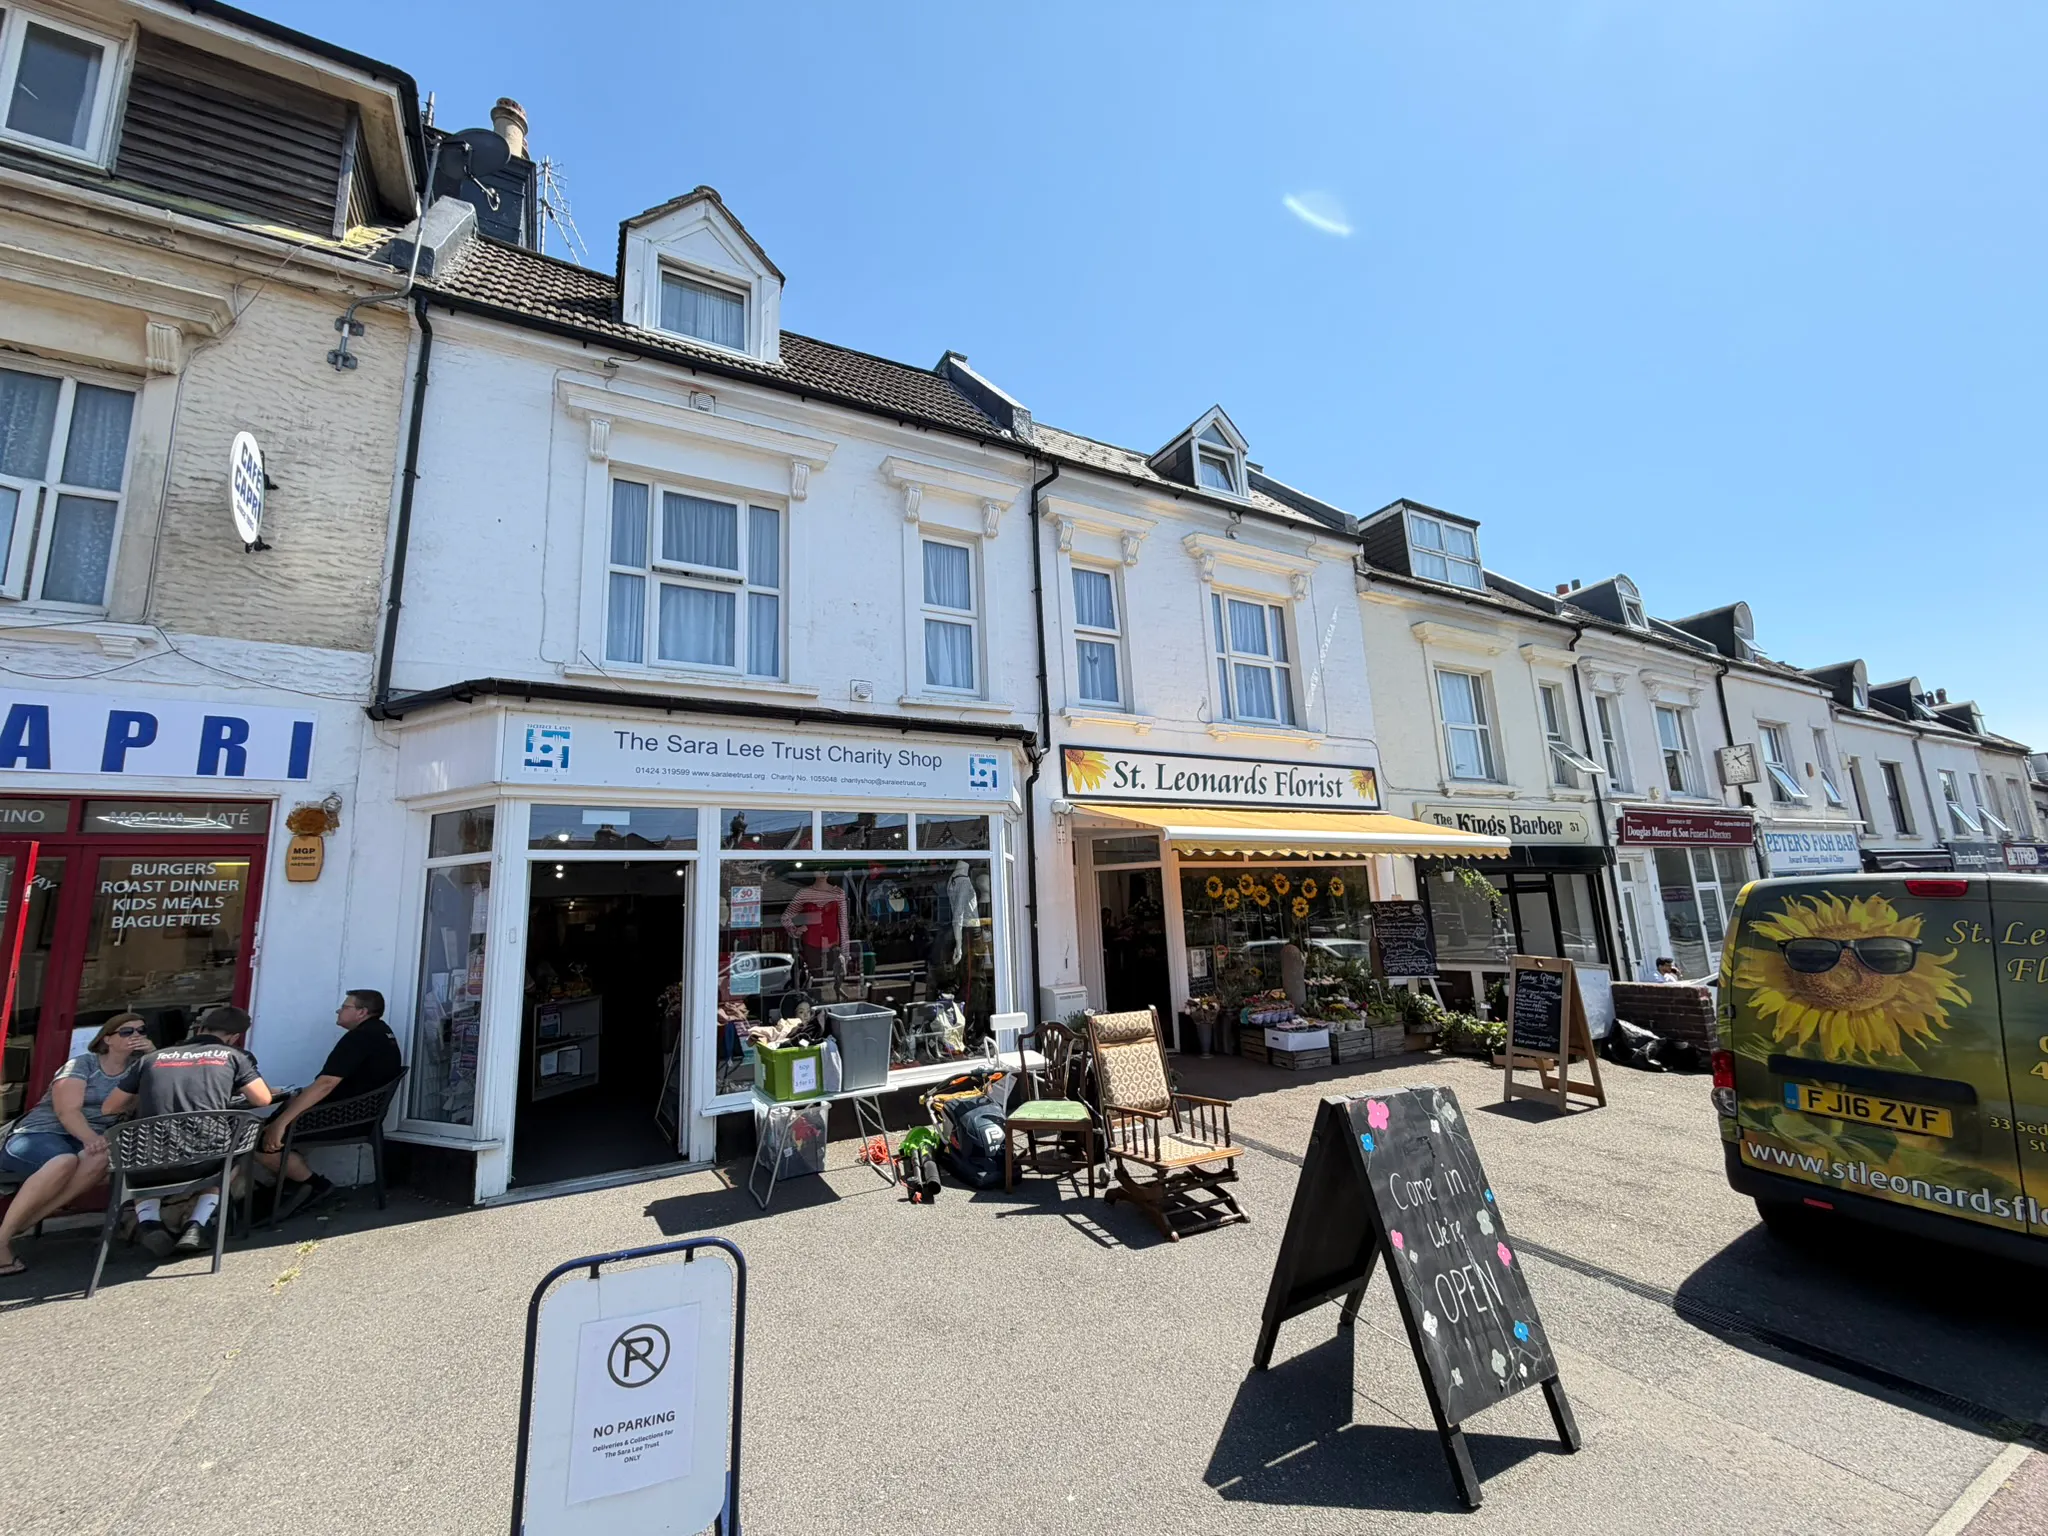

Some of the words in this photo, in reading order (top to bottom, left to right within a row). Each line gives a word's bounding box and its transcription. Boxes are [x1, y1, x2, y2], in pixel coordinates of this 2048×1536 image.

[614, 731, 658, 751] The
[667, 735, 718, 756] Sara
[727, 739, 765, 757] Lee
[772, 742, 820, 761] Trust
[828, 746, 892, 769] Charity
[898, 750, 943, 771] Shop
[661, 768, 690, 776] 319599
[692, 770, 765, 780] www.saraleetrust.org
[771, 774, 795, 783] Charity
[840, 778, 927, 788] charityshop@saraleetrust.org
[1113, 760, 1145, 789] St.
[1155, 763, 1267, 795] Leonards
[1274, 767, 1343, 798] Florist
[109, 811, 185, 824] MOCHA
[1433, 813, 1453, 825] The
[1509, 815, 1563, 835] Barber
[1569, 822, 1580, 832] 31
[1627, 825, 1651, 839] Douglas
[1652, 826, 1672, 837] Mercer
[1672, 827, 1677, 837] &
[1678, 828, 1689, 838] Son
[1690, 828, 1709, 839] Funeral
[1709, 829, 1731, 839] Directors
[1764, 833, 1811, 852] PETER'S
[1811, 834, 1835, 851] FISH
[1836, 834, 1856, 851] BAR
[131, 863, 217, 876] BURGERS
[100, 880, 166, 894] ROAST
[170, 880, 239, 892] DINNER
[112, 898, 157, 911] KIDS
[162, 896, 225, 910] MEALS
[111, 913, 221, 929] BAGUETTES
[1945, 919, 1991, 944] St.
[157, 1051, 180, 1060] Tech
[182, 1049, 212, 1060] Event
[213, 1049, 230, 1059] UK
[1808, 1089, 1870, 1118] FJ16
[1880, 1101, 1940, 1129] ZVF
[1990, 1116, 2011, 1130] 33
[1389, 1173, 1437, 1210] Come
[1440, 1162, 1466, 1195] in
[1426, 1217, 1464, 1249] We're
[1434, 1259, 1504, 1323] OPEN
[593, 1424, 614, 1439] NO
[617, 1410, 676, 1434] PARKING
[592, 1442, 623, 1453] Deliveries
[630, 1432, 664, 1445] Collections
[605, 1451, 617, 1459] The
[617, 1448, 631, 1456] Sara
[632, 1445, 644, 1454] Lee
[644, 1441, 660, 1450] Trust
[624, 1454, 642, 1464] ONLY
